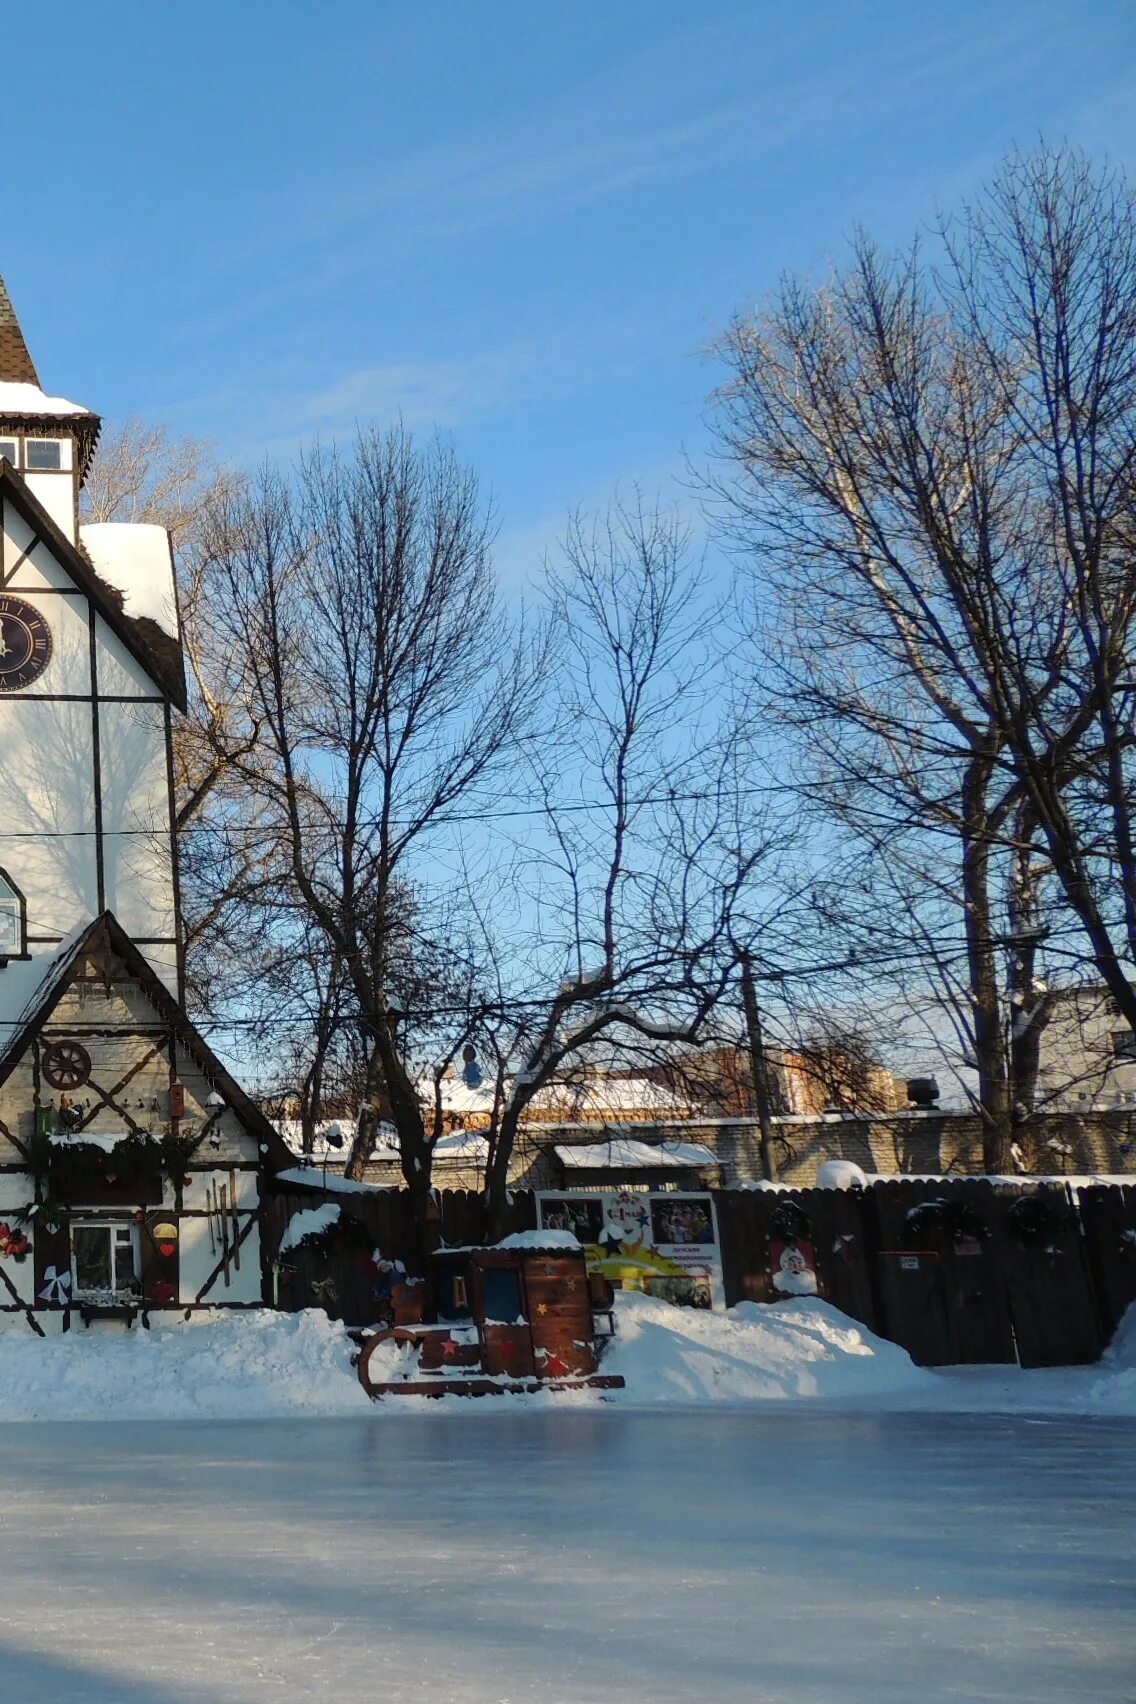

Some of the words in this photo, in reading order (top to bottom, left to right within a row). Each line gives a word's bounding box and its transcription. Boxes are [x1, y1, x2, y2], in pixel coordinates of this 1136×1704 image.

[17, 607, 24, 615] I
[29, 620, 41, 629] II
[35, 638, 46, 649] III
[30, 657, 42, 669] IV
[18, 672, 27, 681] V
